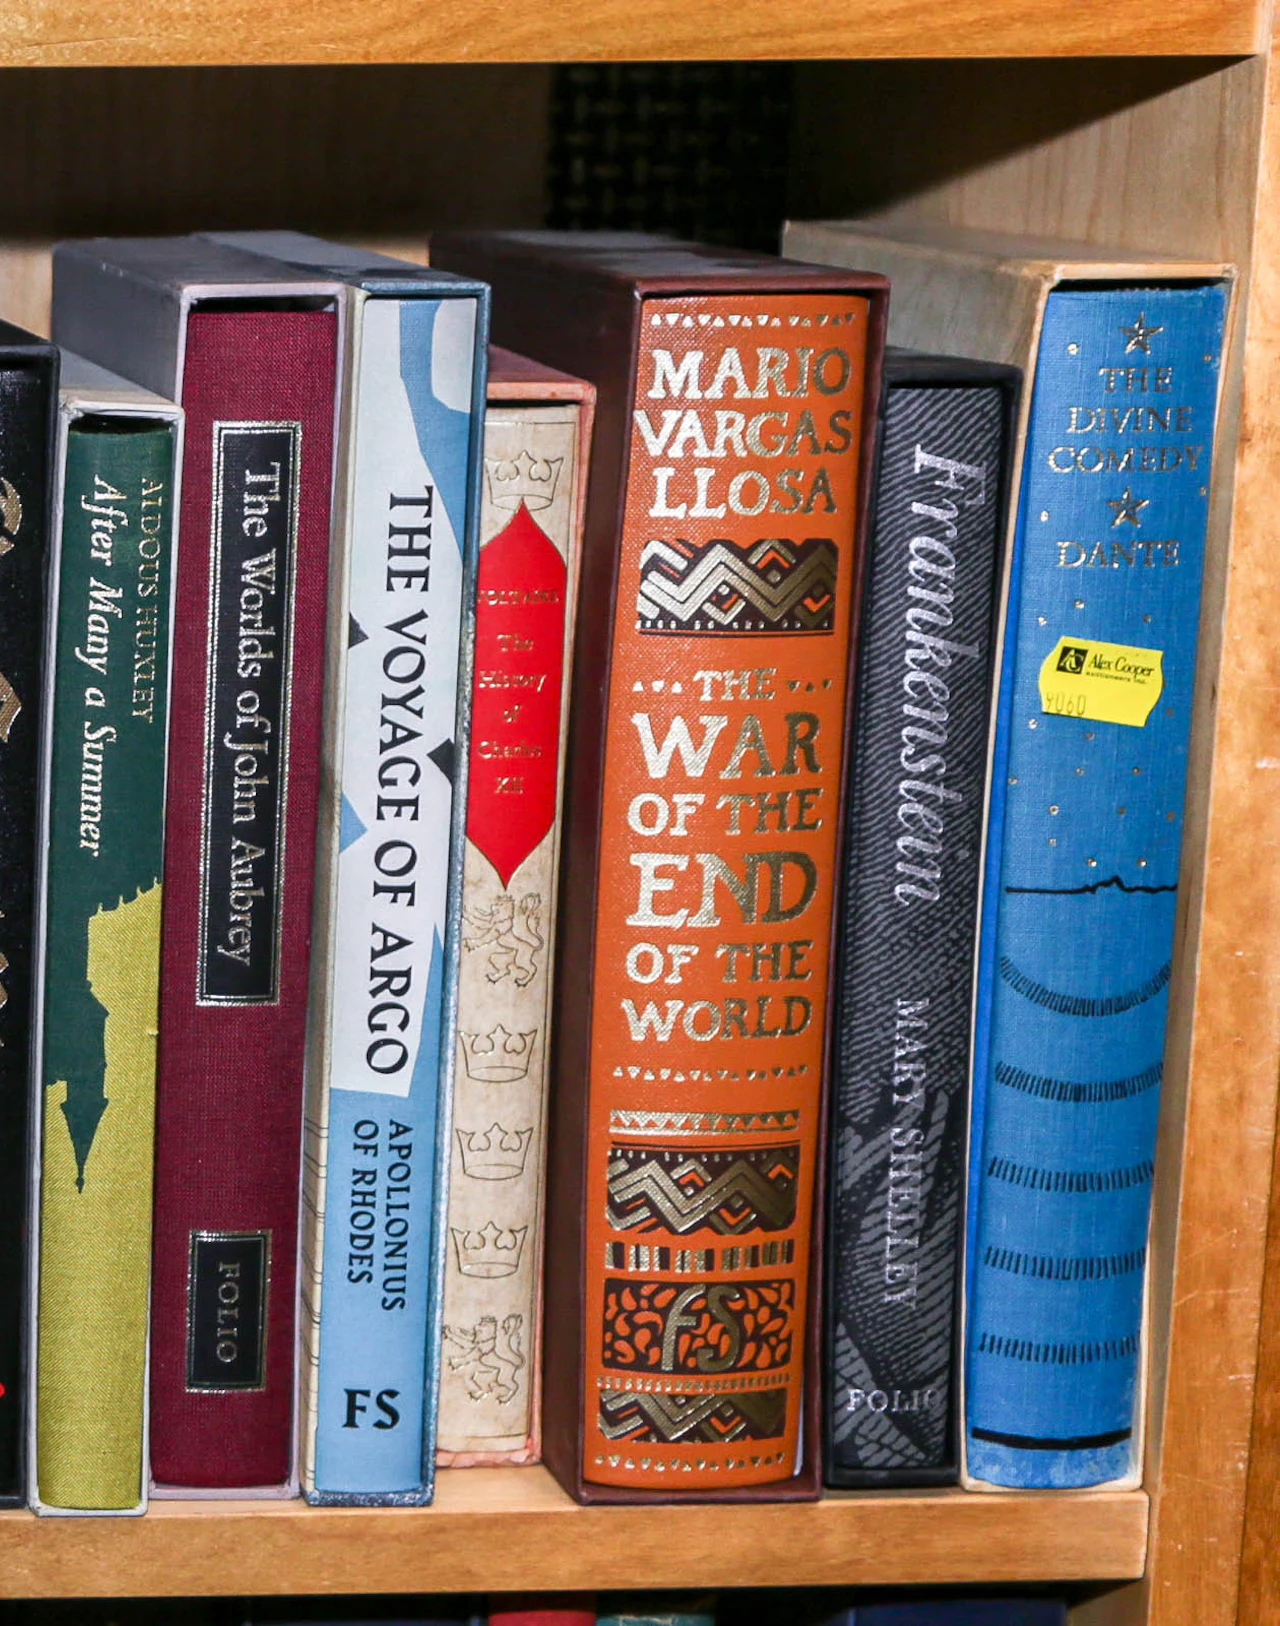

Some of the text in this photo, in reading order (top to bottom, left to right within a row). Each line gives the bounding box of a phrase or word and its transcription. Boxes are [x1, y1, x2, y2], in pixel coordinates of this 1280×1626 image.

[647, 347, 852, 399] MARIO
[1099, 367, 1172, 393] THE
[632, 409, 852, 458] VARGAS
[1067, 407, 1192, 433] DIVINE
[1047, 445, 1204, 473] COMEDY
[648, 466, 838, 519] LLOSA
[1057, 541, 1179, 568] DANTE
[131, 478, 164, 725] ALDOUS HUXLEY
[74, 473, 131, 858] After Many a Summer
[497, 634, 534, 652] The
[1087, 654, 1113, 670] Alex
[1114, 656, 1156, 680] Cooper
[479, 670, 547, 692] History
[693, 668, 777, 702] THE
[894, 443, 986, 906] Frankenstein
[216, 460, 280, 967] The Worlds of John Aubrey
[502, 704, 523, 723] of
[630, 711, 823, 779] WAR
[365, 484, 433, 1076] THE VOYAGE OF ARGO
[627, 788, 823, 836] OF THE
[626, 851, 818, 929] END
[626, 940, 813, 985] OF THE
[621, 996, 812, 1042] WORLD
[885, 998, 930, 1310] MARY SHELLEY
[346, 1119, 379, 1285] OF RHODES
[381, 1119, 414, 1312] APOLLONIUS
[216, 1261, 242, 1364] FOLIO
[342, 1388, 401, 1430] FS
